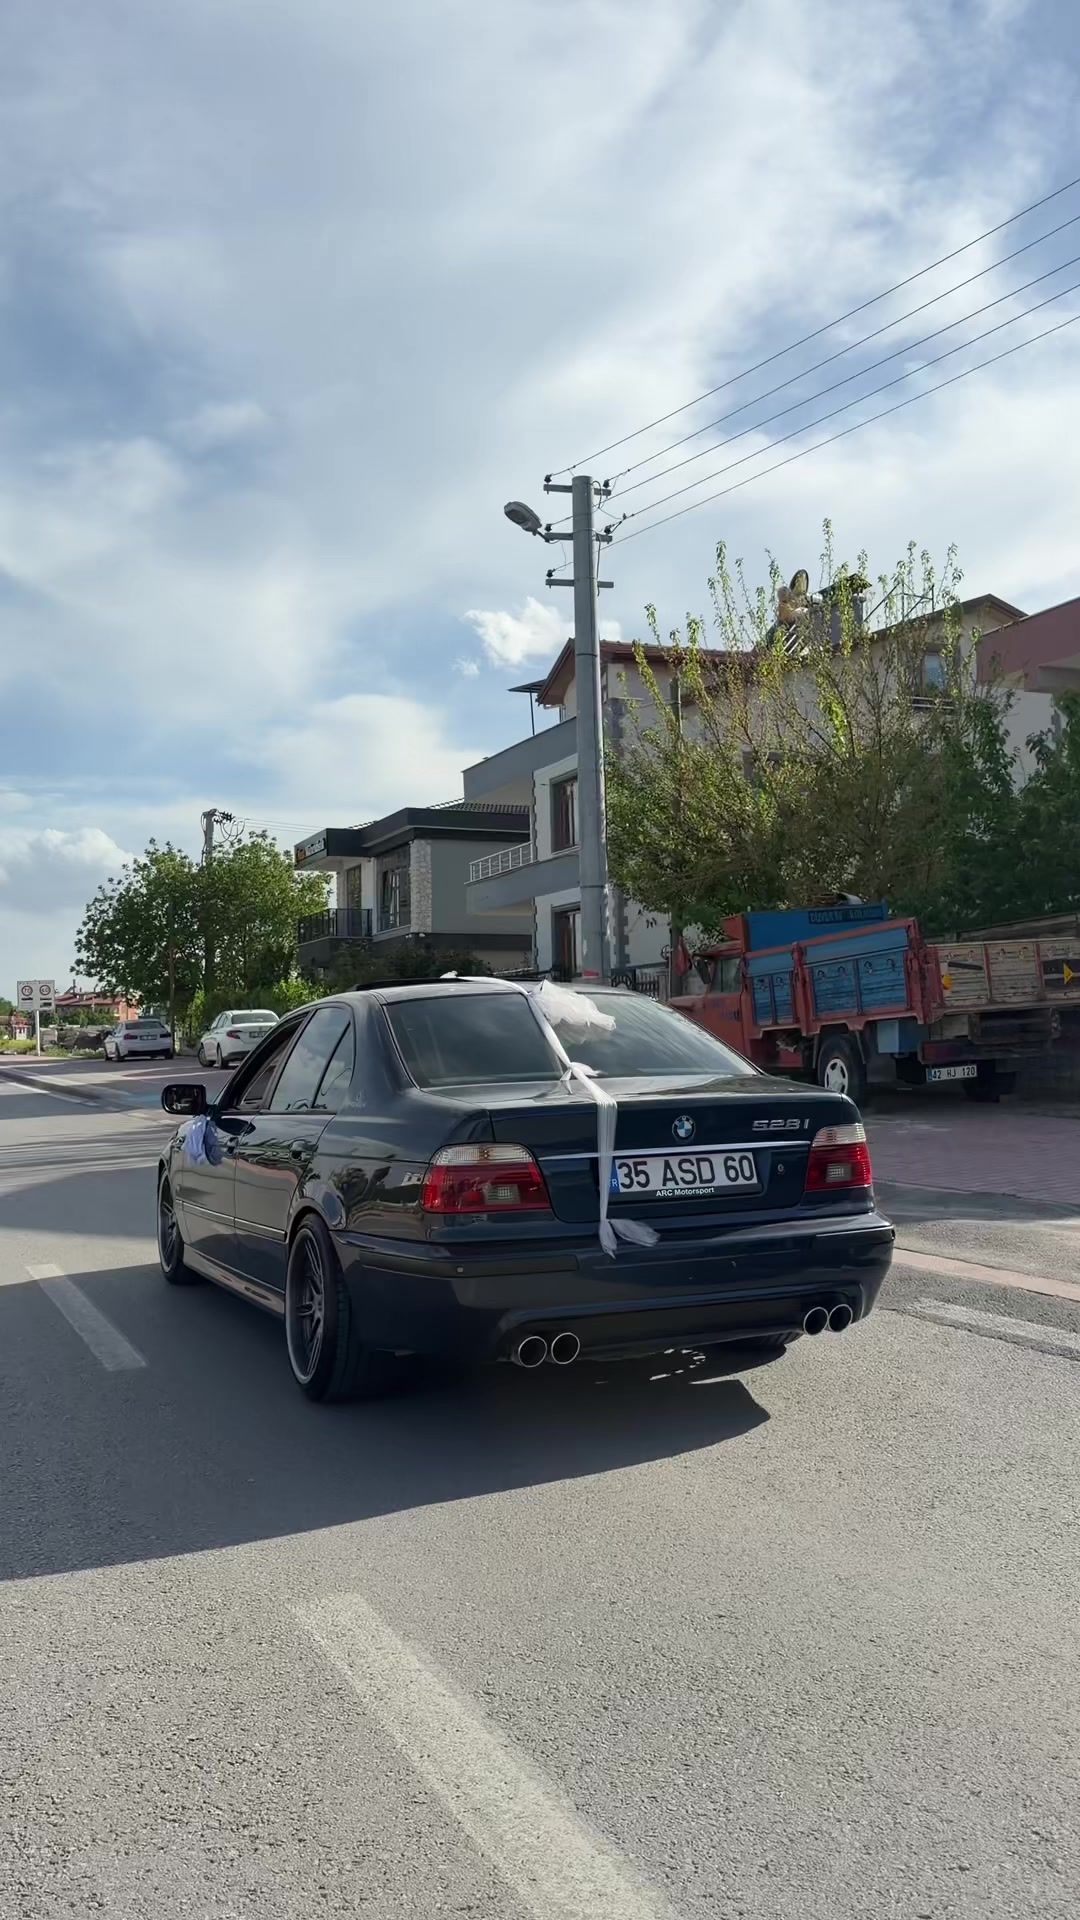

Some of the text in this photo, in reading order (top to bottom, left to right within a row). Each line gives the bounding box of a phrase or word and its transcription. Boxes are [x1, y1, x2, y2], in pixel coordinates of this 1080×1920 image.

[962, 1066, 976, 1077] 120
[617, 1160, 651, 1190] 35
[661, 1156, 716, 1187] ASD
[723, 1155, 755, 1183] 60
[655, 1187, 715, 1197] ARC Motorsport
